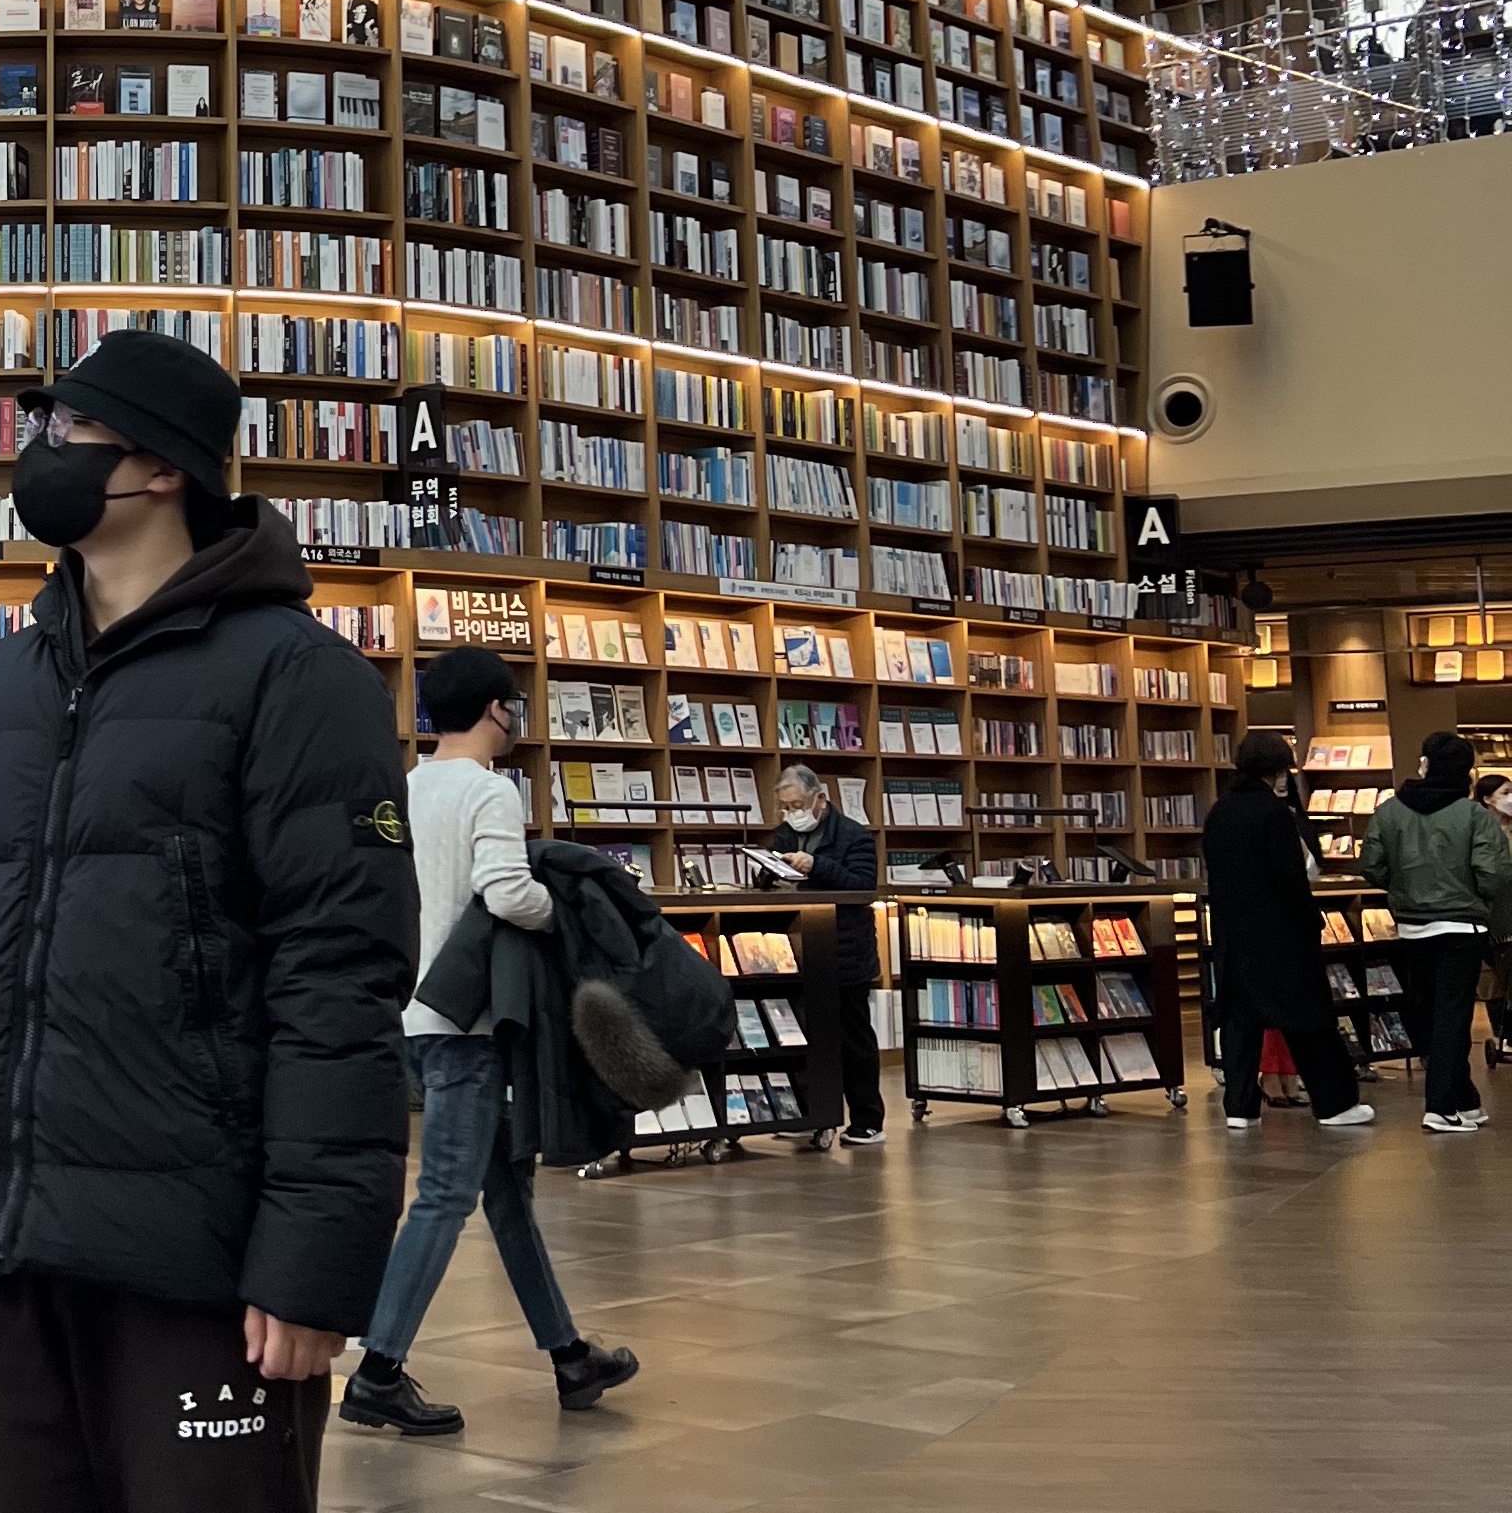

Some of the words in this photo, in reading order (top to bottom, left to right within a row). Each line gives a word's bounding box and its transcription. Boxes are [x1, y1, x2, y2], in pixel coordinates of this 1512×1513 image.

[410, 400, 438, 452] A
[411, 477, 439, 501] 무역
[412, 504, 439, 528] 협회
[448, 487, 458, 519] KITA
[1138, 506, 1170, 546] A
[301, 547, 324, 561] A16
[328, 548, 361, 560] 외국소설
[1138, 573, 1177, 594] 소설
[1185, 569, 1196, 605] Fiction
[451, 591, 529, 619] 비즈니스
[453, 619, 531, 645] 라이브러리
[178, 1415, 266, 1438] STUDIO
